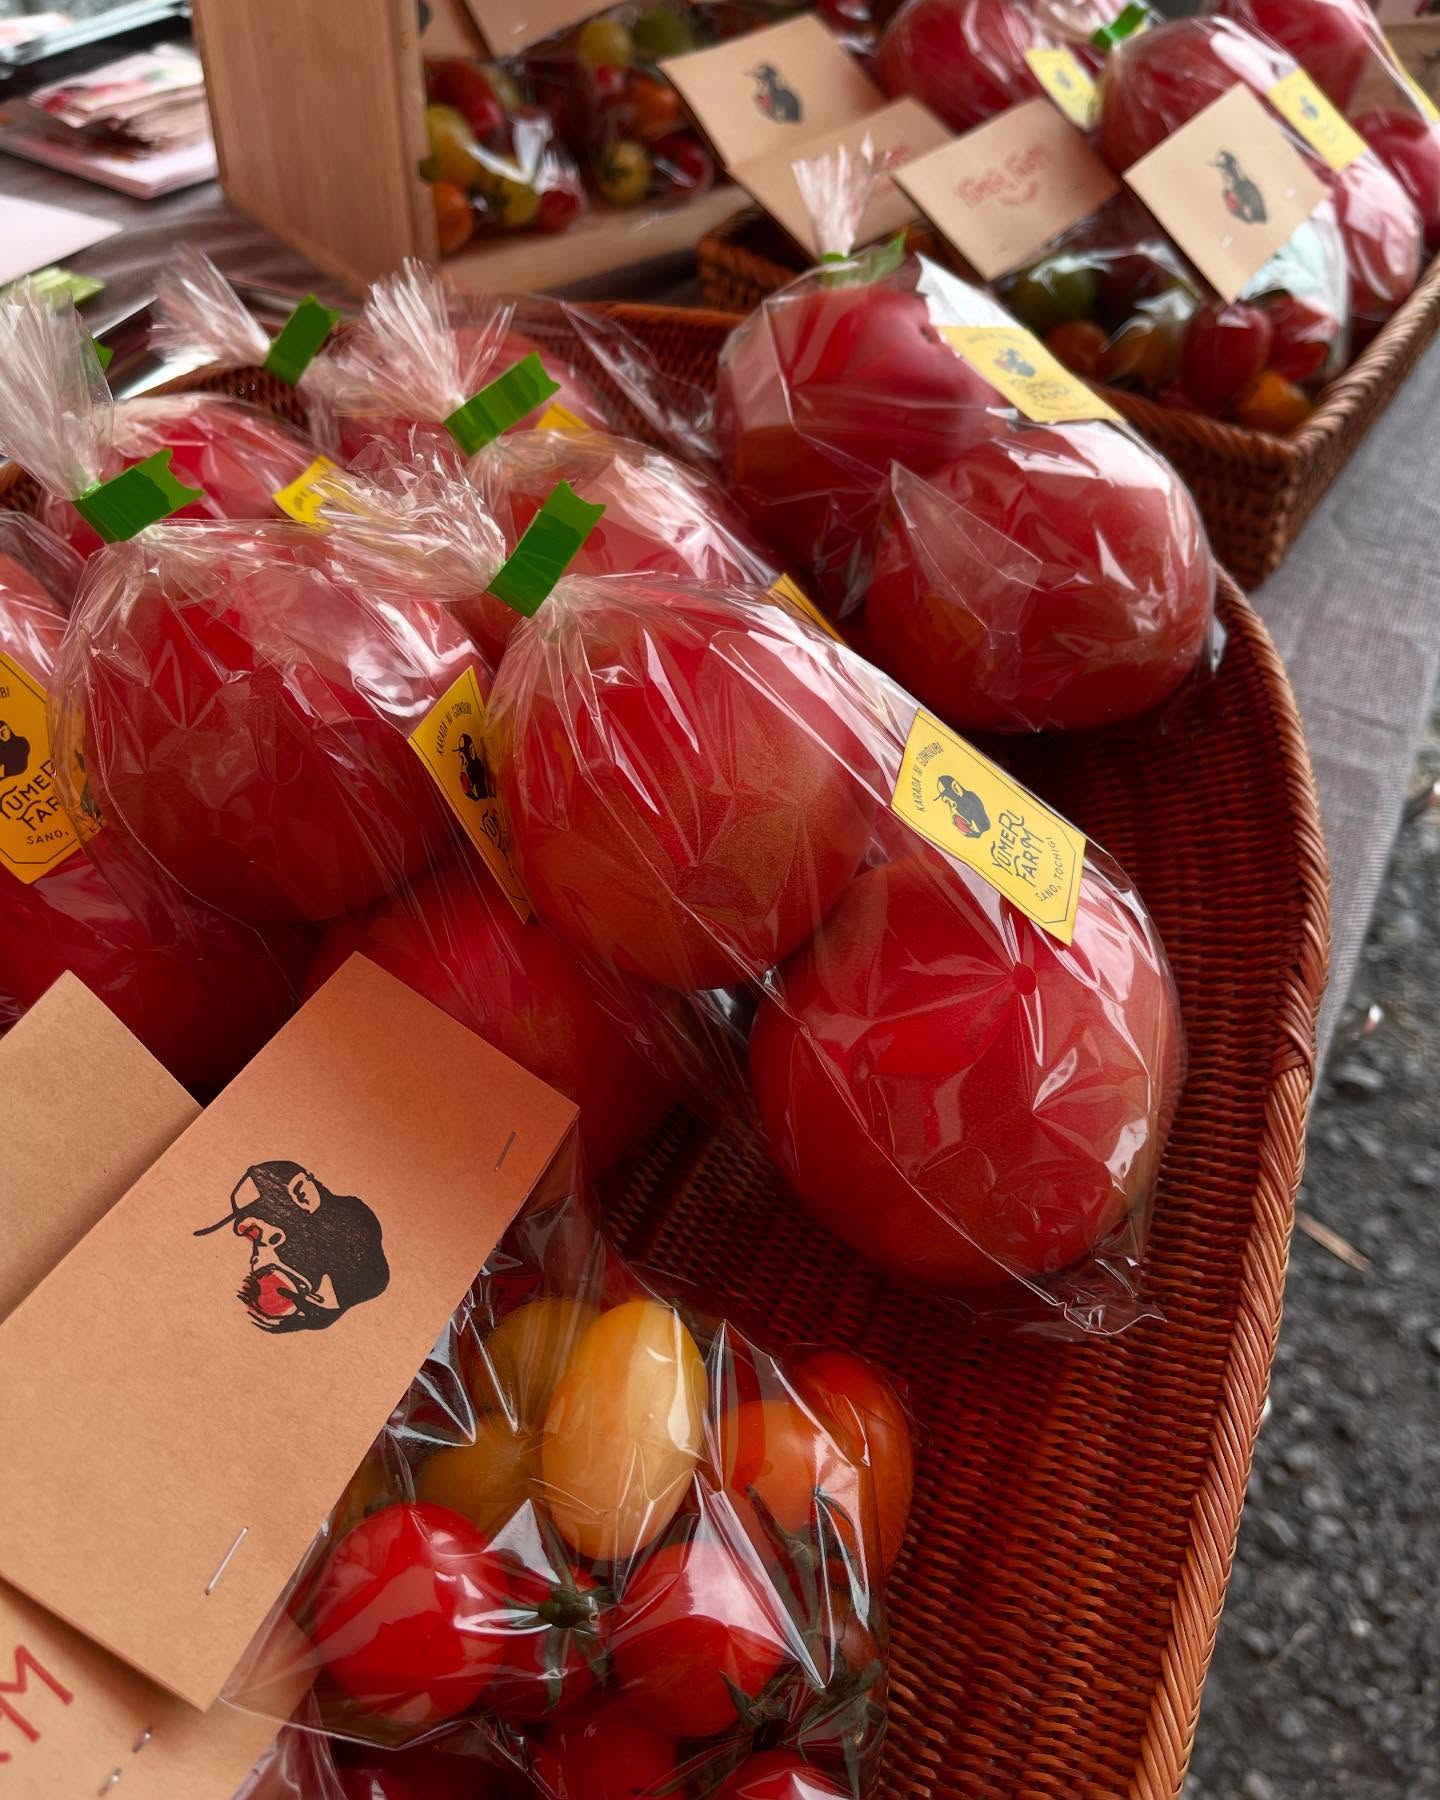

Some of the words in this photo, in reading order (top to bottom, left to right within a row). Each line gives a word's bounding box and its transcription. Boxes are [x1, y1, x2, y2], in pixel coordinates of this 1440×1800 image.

[915, 741, 944, 767] GOHOUBI
[912, 764, 923, 776] NI
[911, 776, 926, 812] KARADA
[26, 829, 69, 845] SANO,
[990, 809, 1025, 876] YUMERI
[1015, 827, 1045, 888] FARM
[1045, 836, 1064, 880] TOCHIGI
[1035, 883, 1062, 902] SANO,
